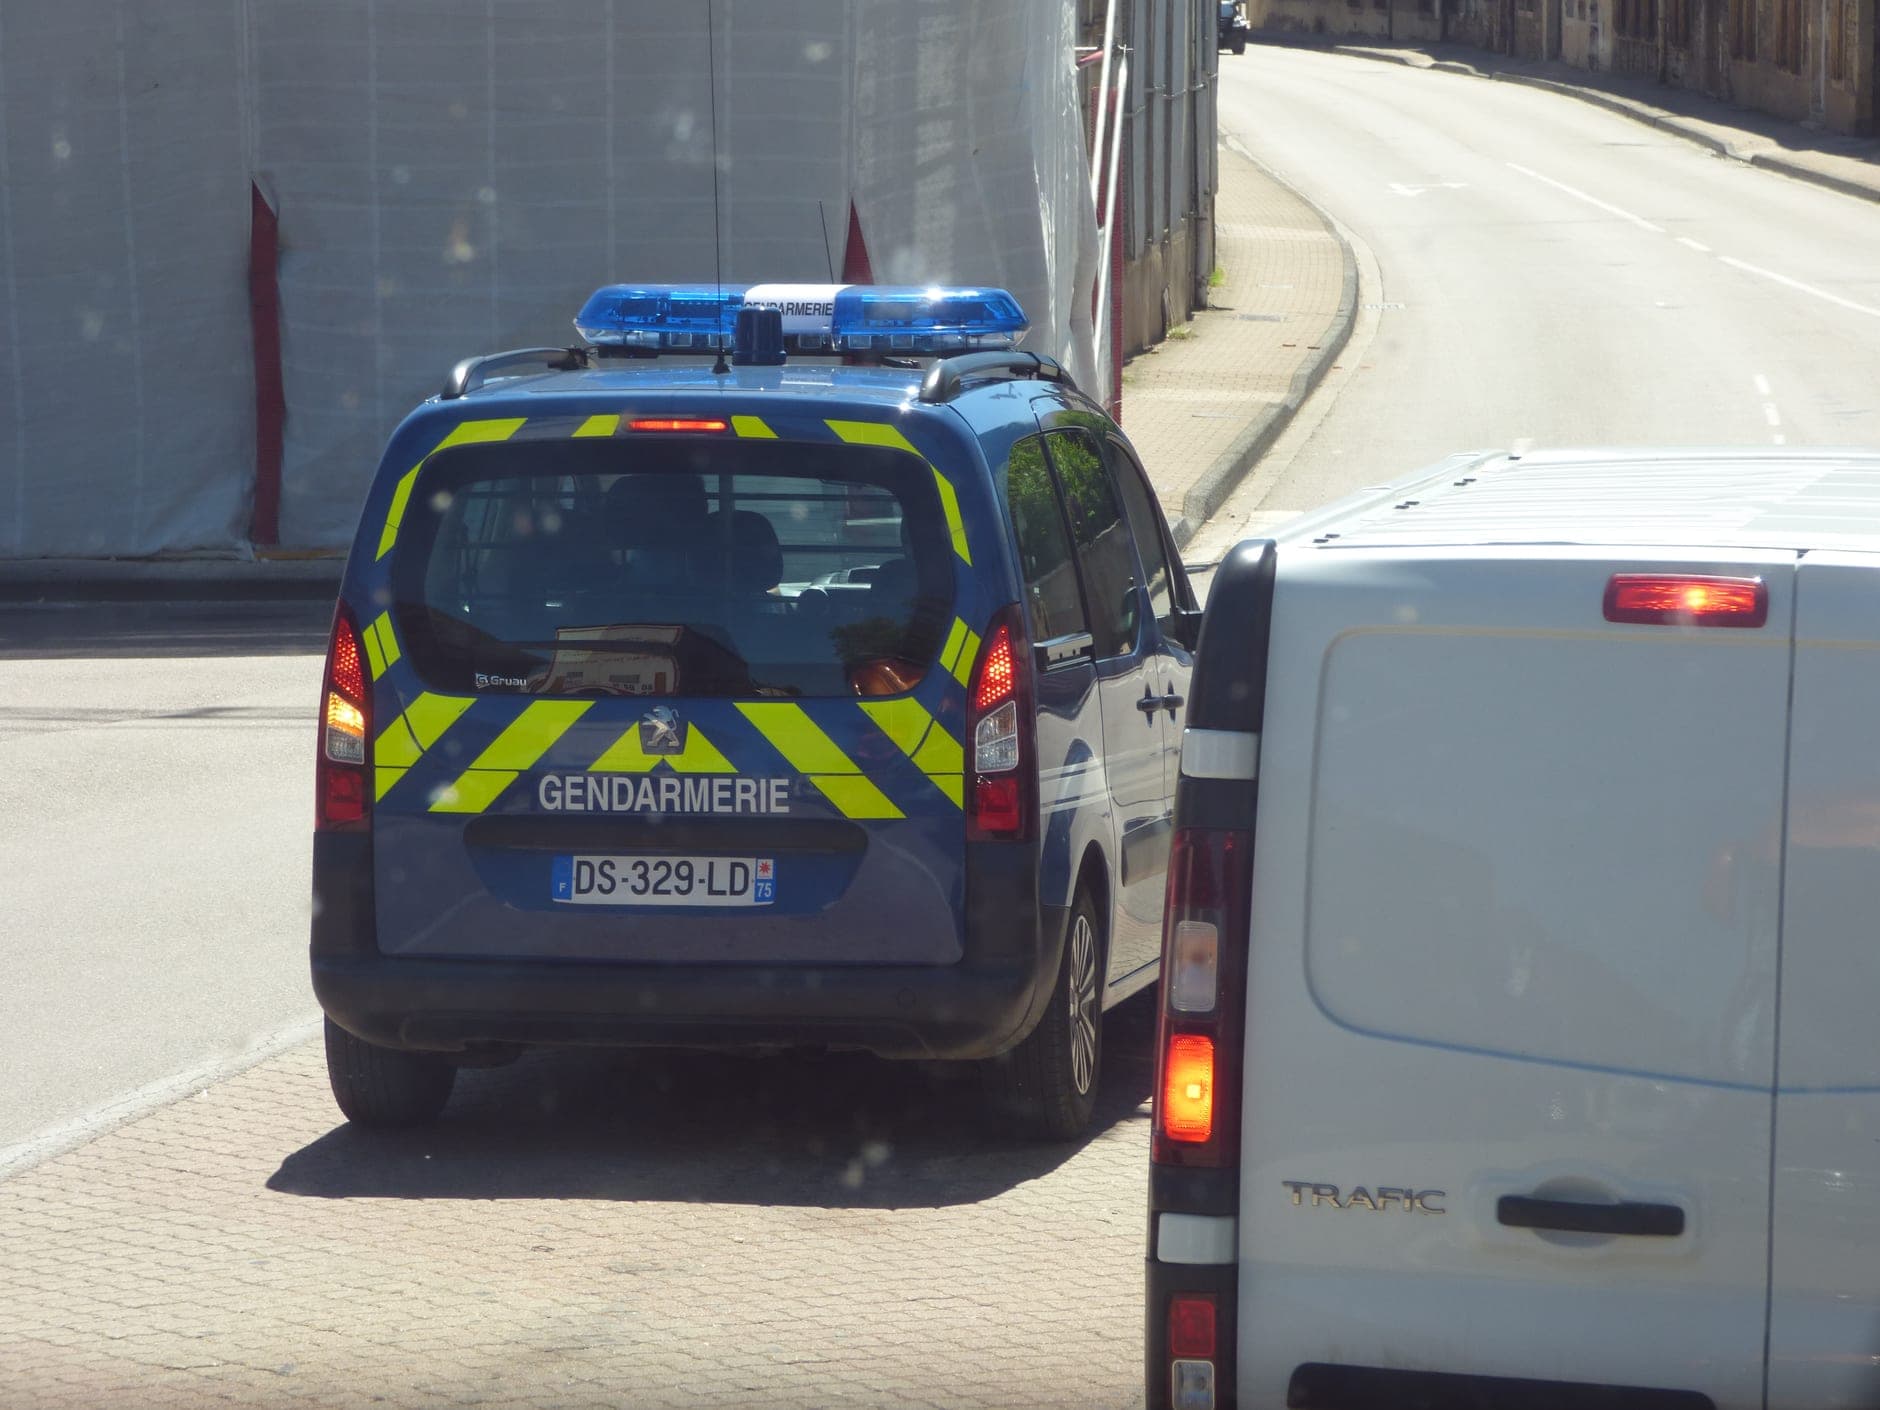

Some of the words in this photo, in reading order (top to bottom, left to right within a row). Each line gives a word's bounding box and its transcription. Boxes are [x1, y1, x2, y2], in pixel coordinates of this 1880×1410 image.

[490, 675, 527, 686] Gruau
[538, 775, 790, 814] GENDARMERIE
[559, 882, 566, 893] F
[575, 860, 750, 897] DS-329-LD
[756, 882, 772, 898] 75
[1282, 1180, 1446, 1215] TRAFIC
